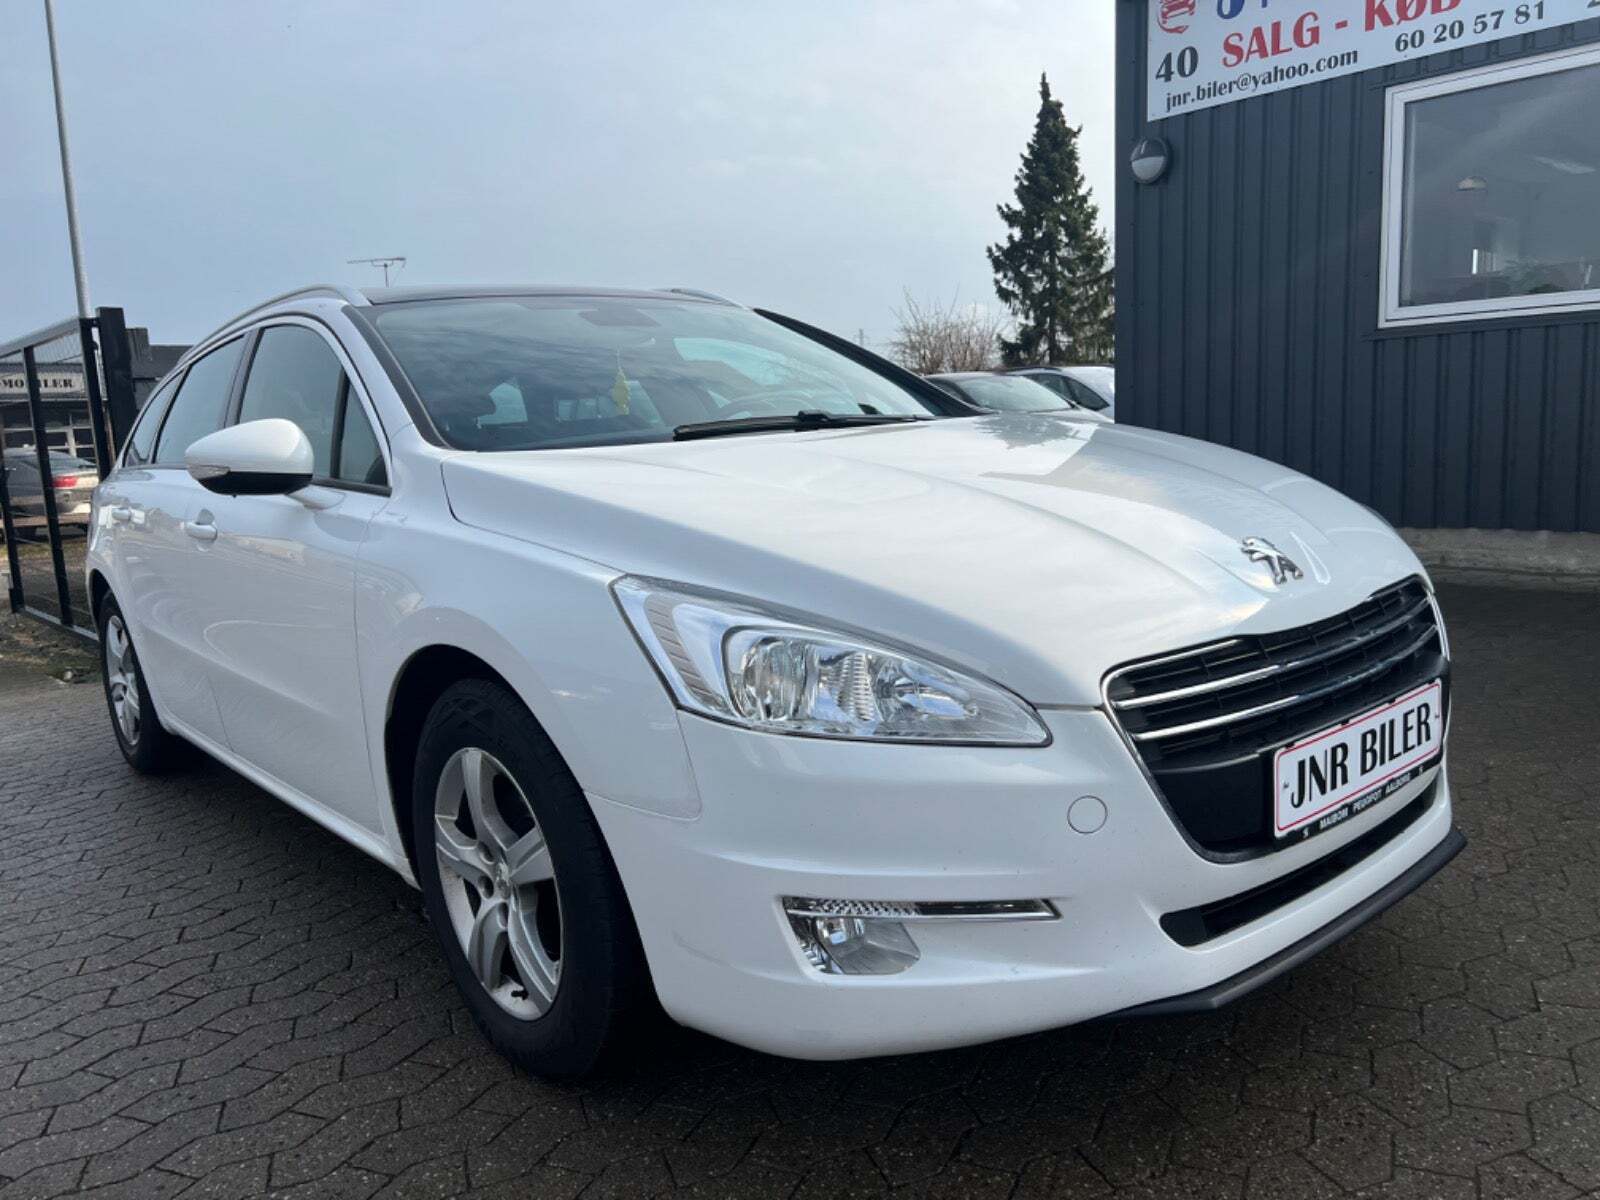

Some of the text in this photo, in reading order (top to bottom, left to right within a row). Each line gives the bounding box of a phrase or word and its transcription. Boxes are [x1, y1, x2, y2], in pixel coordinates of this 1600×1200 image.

[1222, 10, 1319, 68] SALG
[1394, 1, 1545, 53] 60 20 57 81
[1155, 45, 1199, 83] 40
[1166, 50, 1359, 113] jnr.biler@yahoo.com
[1291, 702, 1432, 809] JNR BILER
